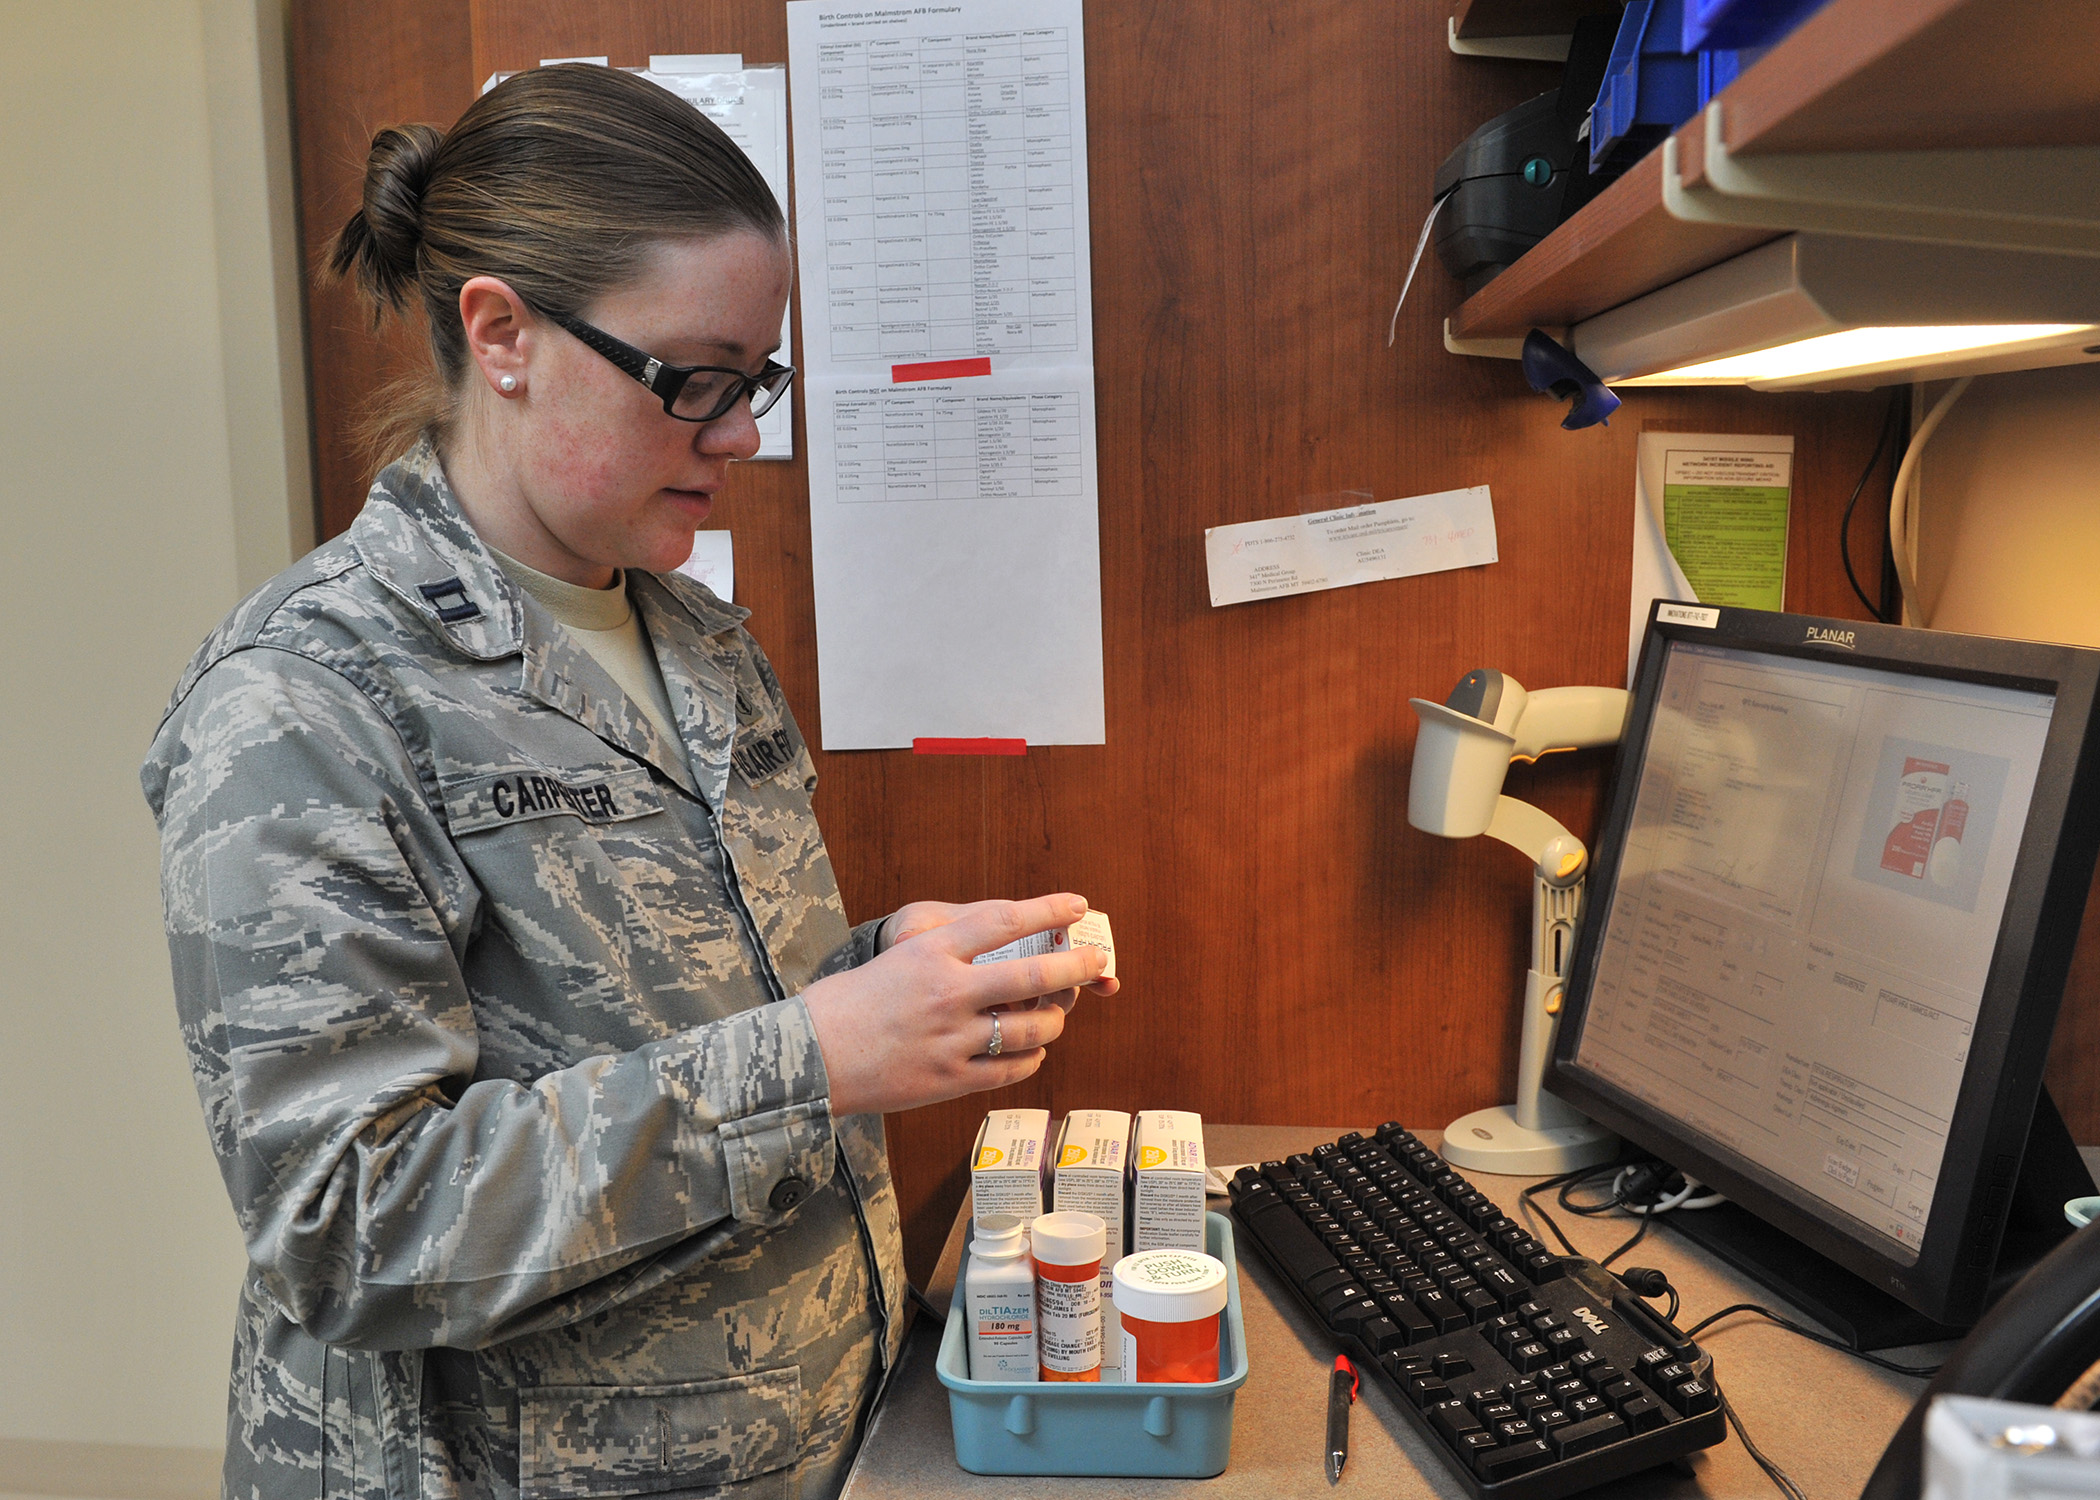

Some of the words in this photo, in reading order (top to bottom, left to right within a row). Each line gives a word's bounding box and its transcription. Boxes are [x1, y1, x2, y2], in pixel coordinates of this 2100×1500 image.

[836, 11, 863, 20] Controls
[874, 9, 912, 17] Malmstrom
[928, 6, 961, 14] Formulary
[1307, 516, 1328, 525] General
[1806, 626, 1855, 644] PLANAR
[746, 740, 784, 777] AIR
[1144, 1259, 1182, 1270] PUSH
[1147, 1263, 1192, 1275] DOWN
[1162, 1267, 1201, 1278] TURN
[979, 1306, 1029, 1315] DILTIAZEM
[991, 1322, 1005, 1330] 180
[1007, 1323, 1020, 1331] mg
[1572, 1306, 1610, 1336] DELL
